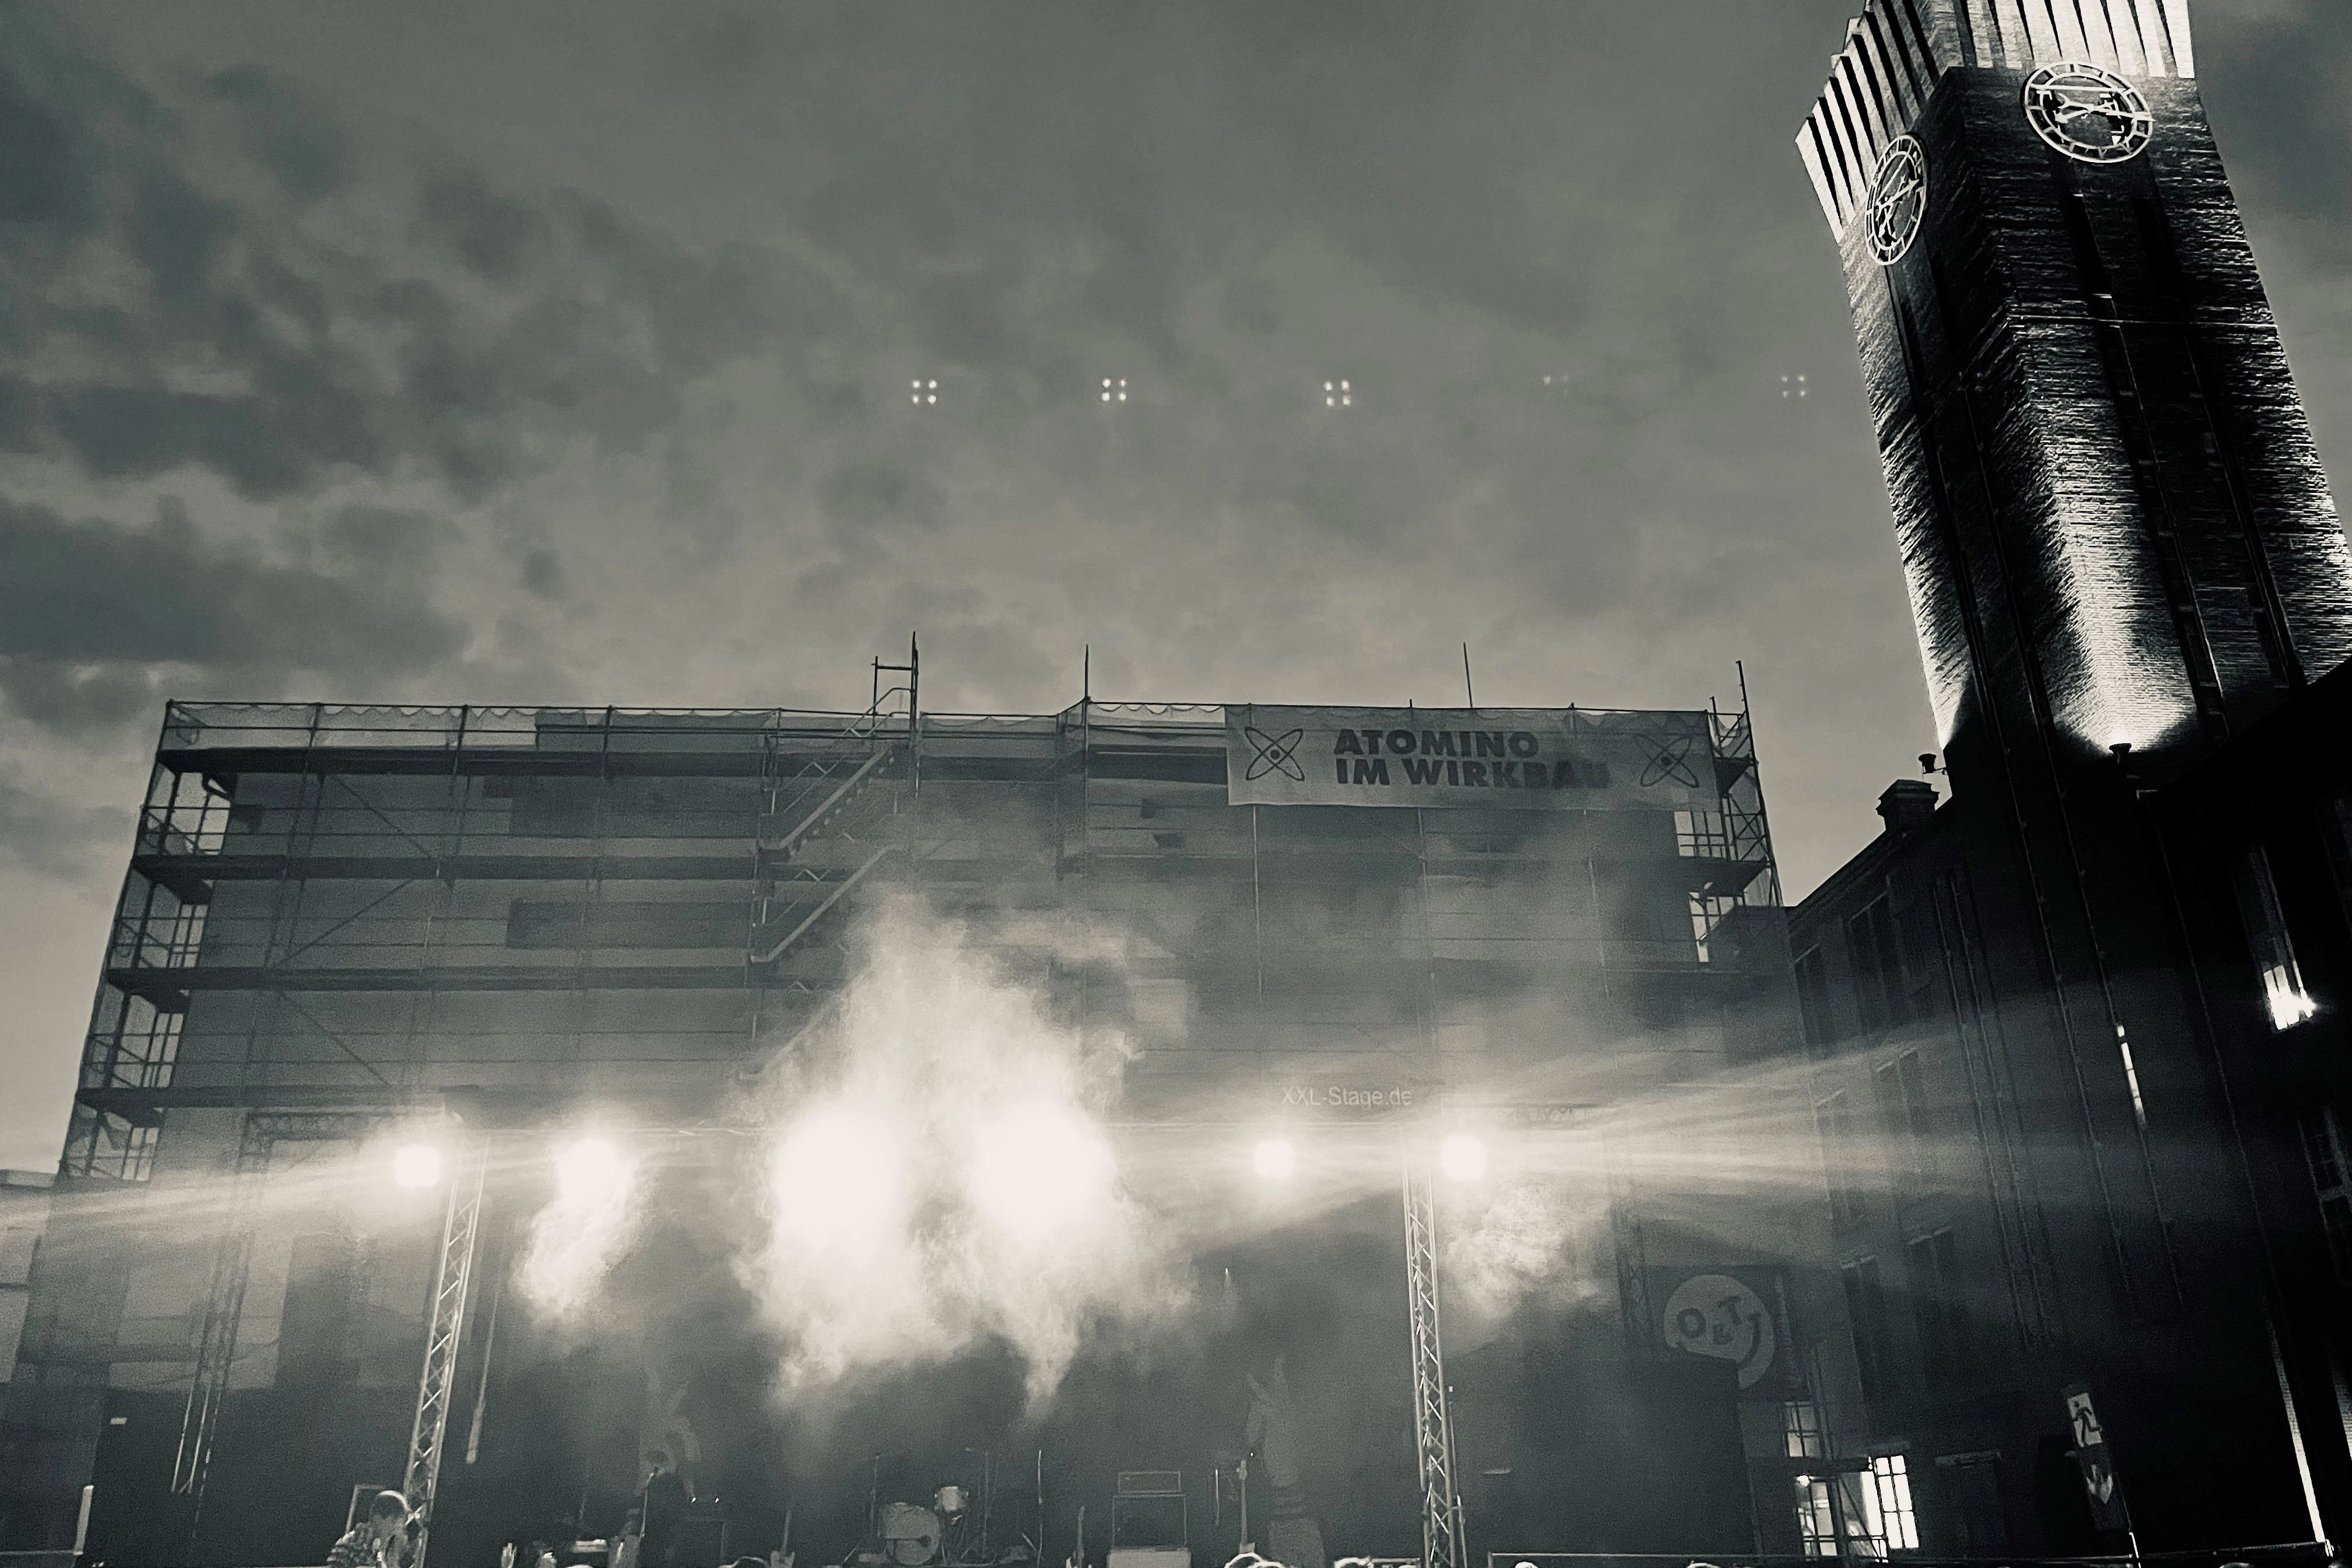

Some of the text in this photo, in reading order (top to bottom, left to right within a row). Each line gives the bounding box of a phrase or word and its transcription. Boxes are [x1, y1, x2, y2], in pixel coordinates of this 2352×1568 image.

[1334, 728, 1539, 758] ATOMINO
[1335, 758, 1391, 786] IM
[1281, 1085, 1413, 1108] XXL-Stage.de
